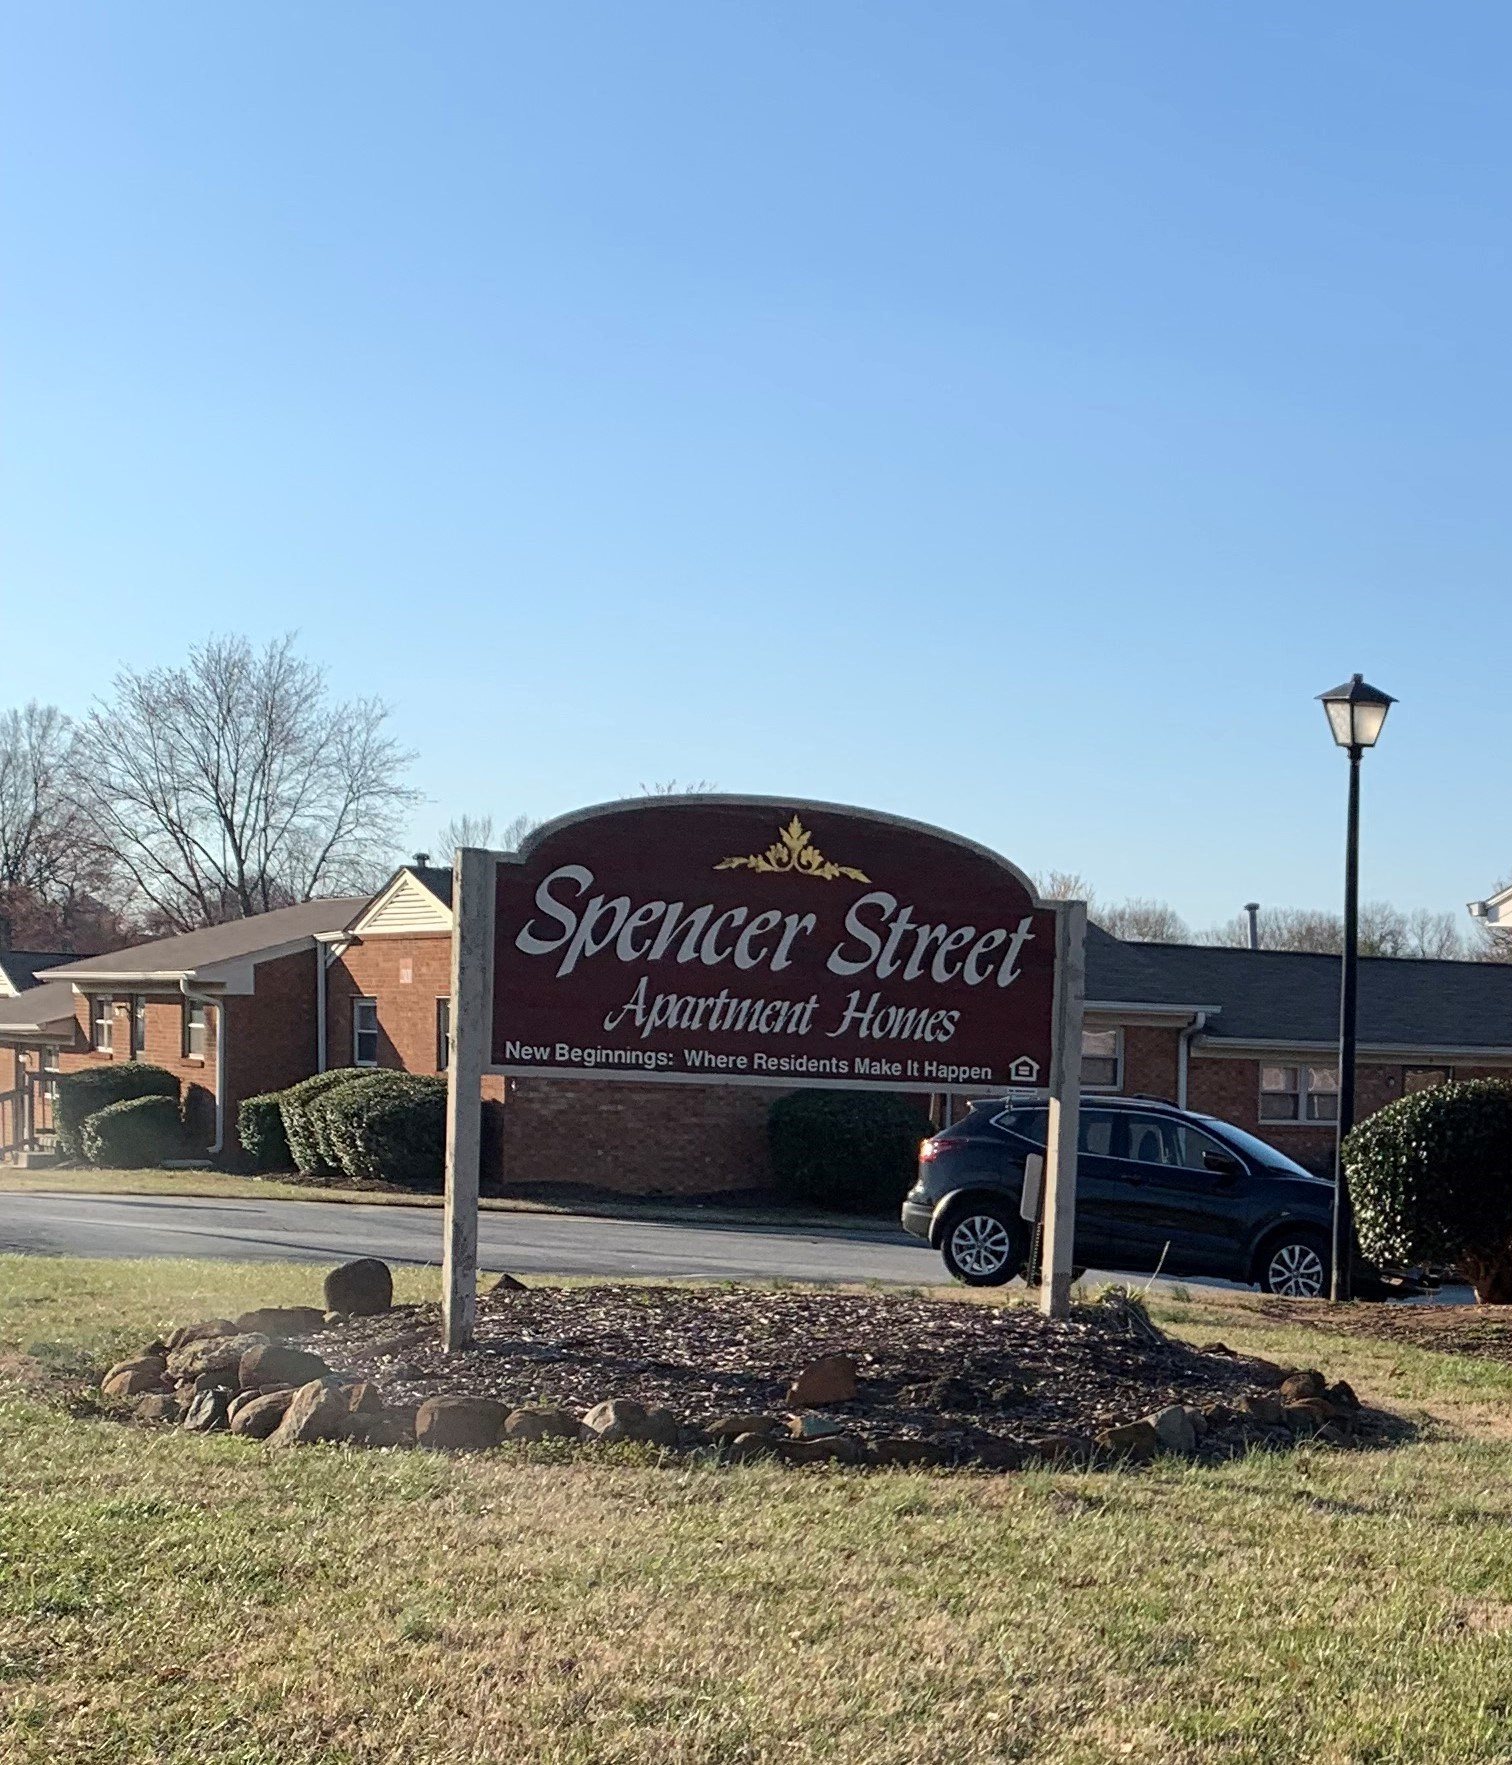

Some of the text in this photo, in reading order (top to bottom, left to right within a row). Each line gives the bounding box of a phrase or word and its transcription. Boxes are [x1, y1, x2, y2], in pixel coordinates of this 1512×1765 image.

[515, 864, 1035, 988] Spencer Street
[604, 976, 961, 1043] Apartment Homes
[505, 1041, 992, 1082] New Beginnings: Where Residents Make It Happen
